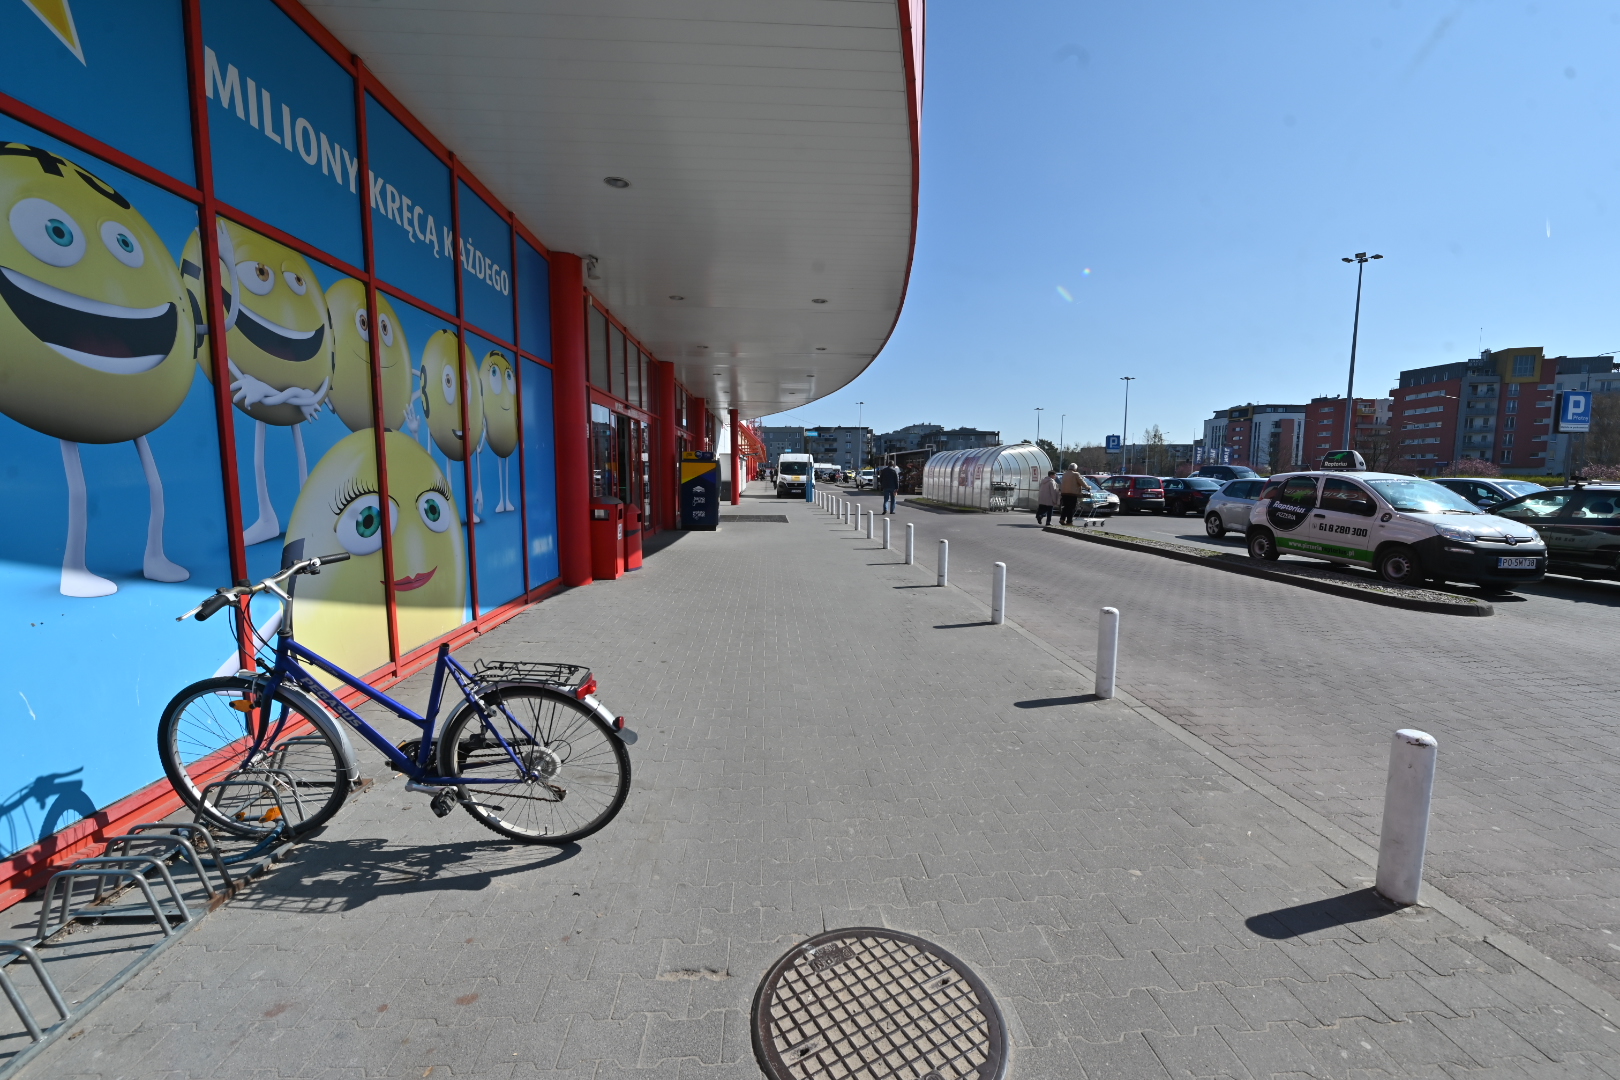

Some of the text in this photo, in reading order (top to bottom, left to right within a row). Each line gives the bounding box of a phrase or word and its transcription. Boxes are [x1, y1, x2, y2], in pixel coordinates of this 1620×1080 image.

[204, 45, 509, 296] MILIONY KRĘCĄ KAŻDEGO
[1567, 395, 1586, 420] P
[1272, 500, 1306, 514] Raptorius
[1276, 511, 1296, 521] PIZZERIA
[1335, 525, 1350, 535] 280
[1351, 527, 1368, 537] 300
[300, 676, 362, 727] PEGASUS
